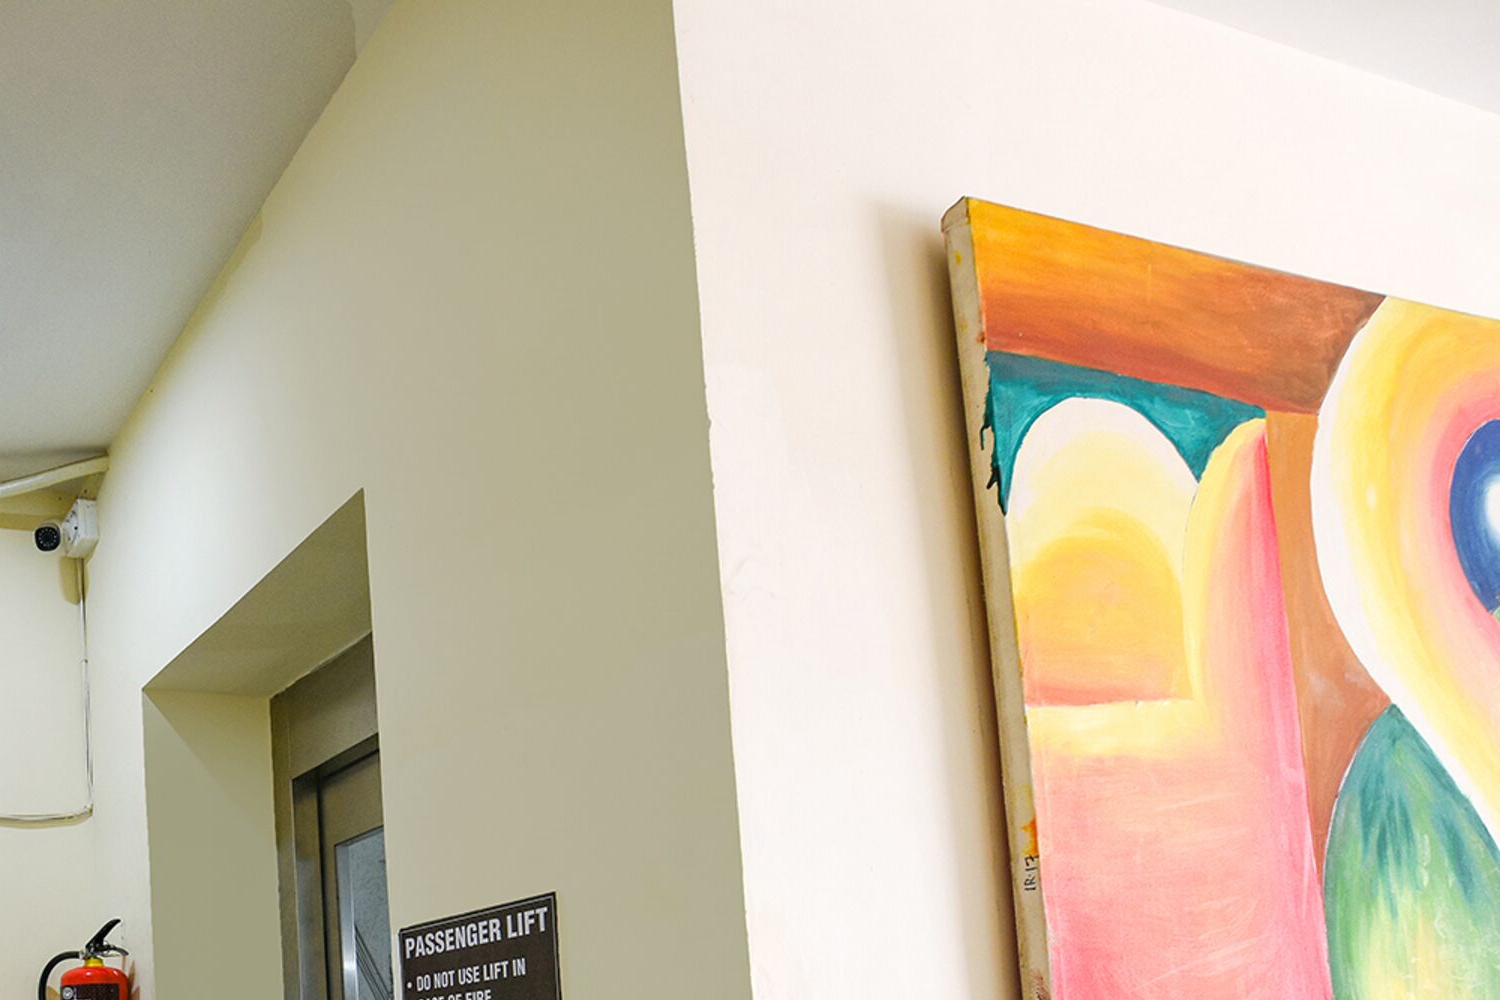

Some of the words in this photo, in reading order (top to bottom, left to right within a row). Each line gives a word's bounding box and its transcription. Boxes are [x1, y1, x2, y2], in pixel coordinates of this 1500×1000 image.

[405, 918, 501, 959] PASSENGER
[506, 907, 548, 938] LIFT
[416, 974, 431, 992] DO
[434, 970, 455, 989] NOT
[458, 966, 480, 985] USE
[483, 961, 509, 981] LIFT
[512, 958, 526, 976] IN
